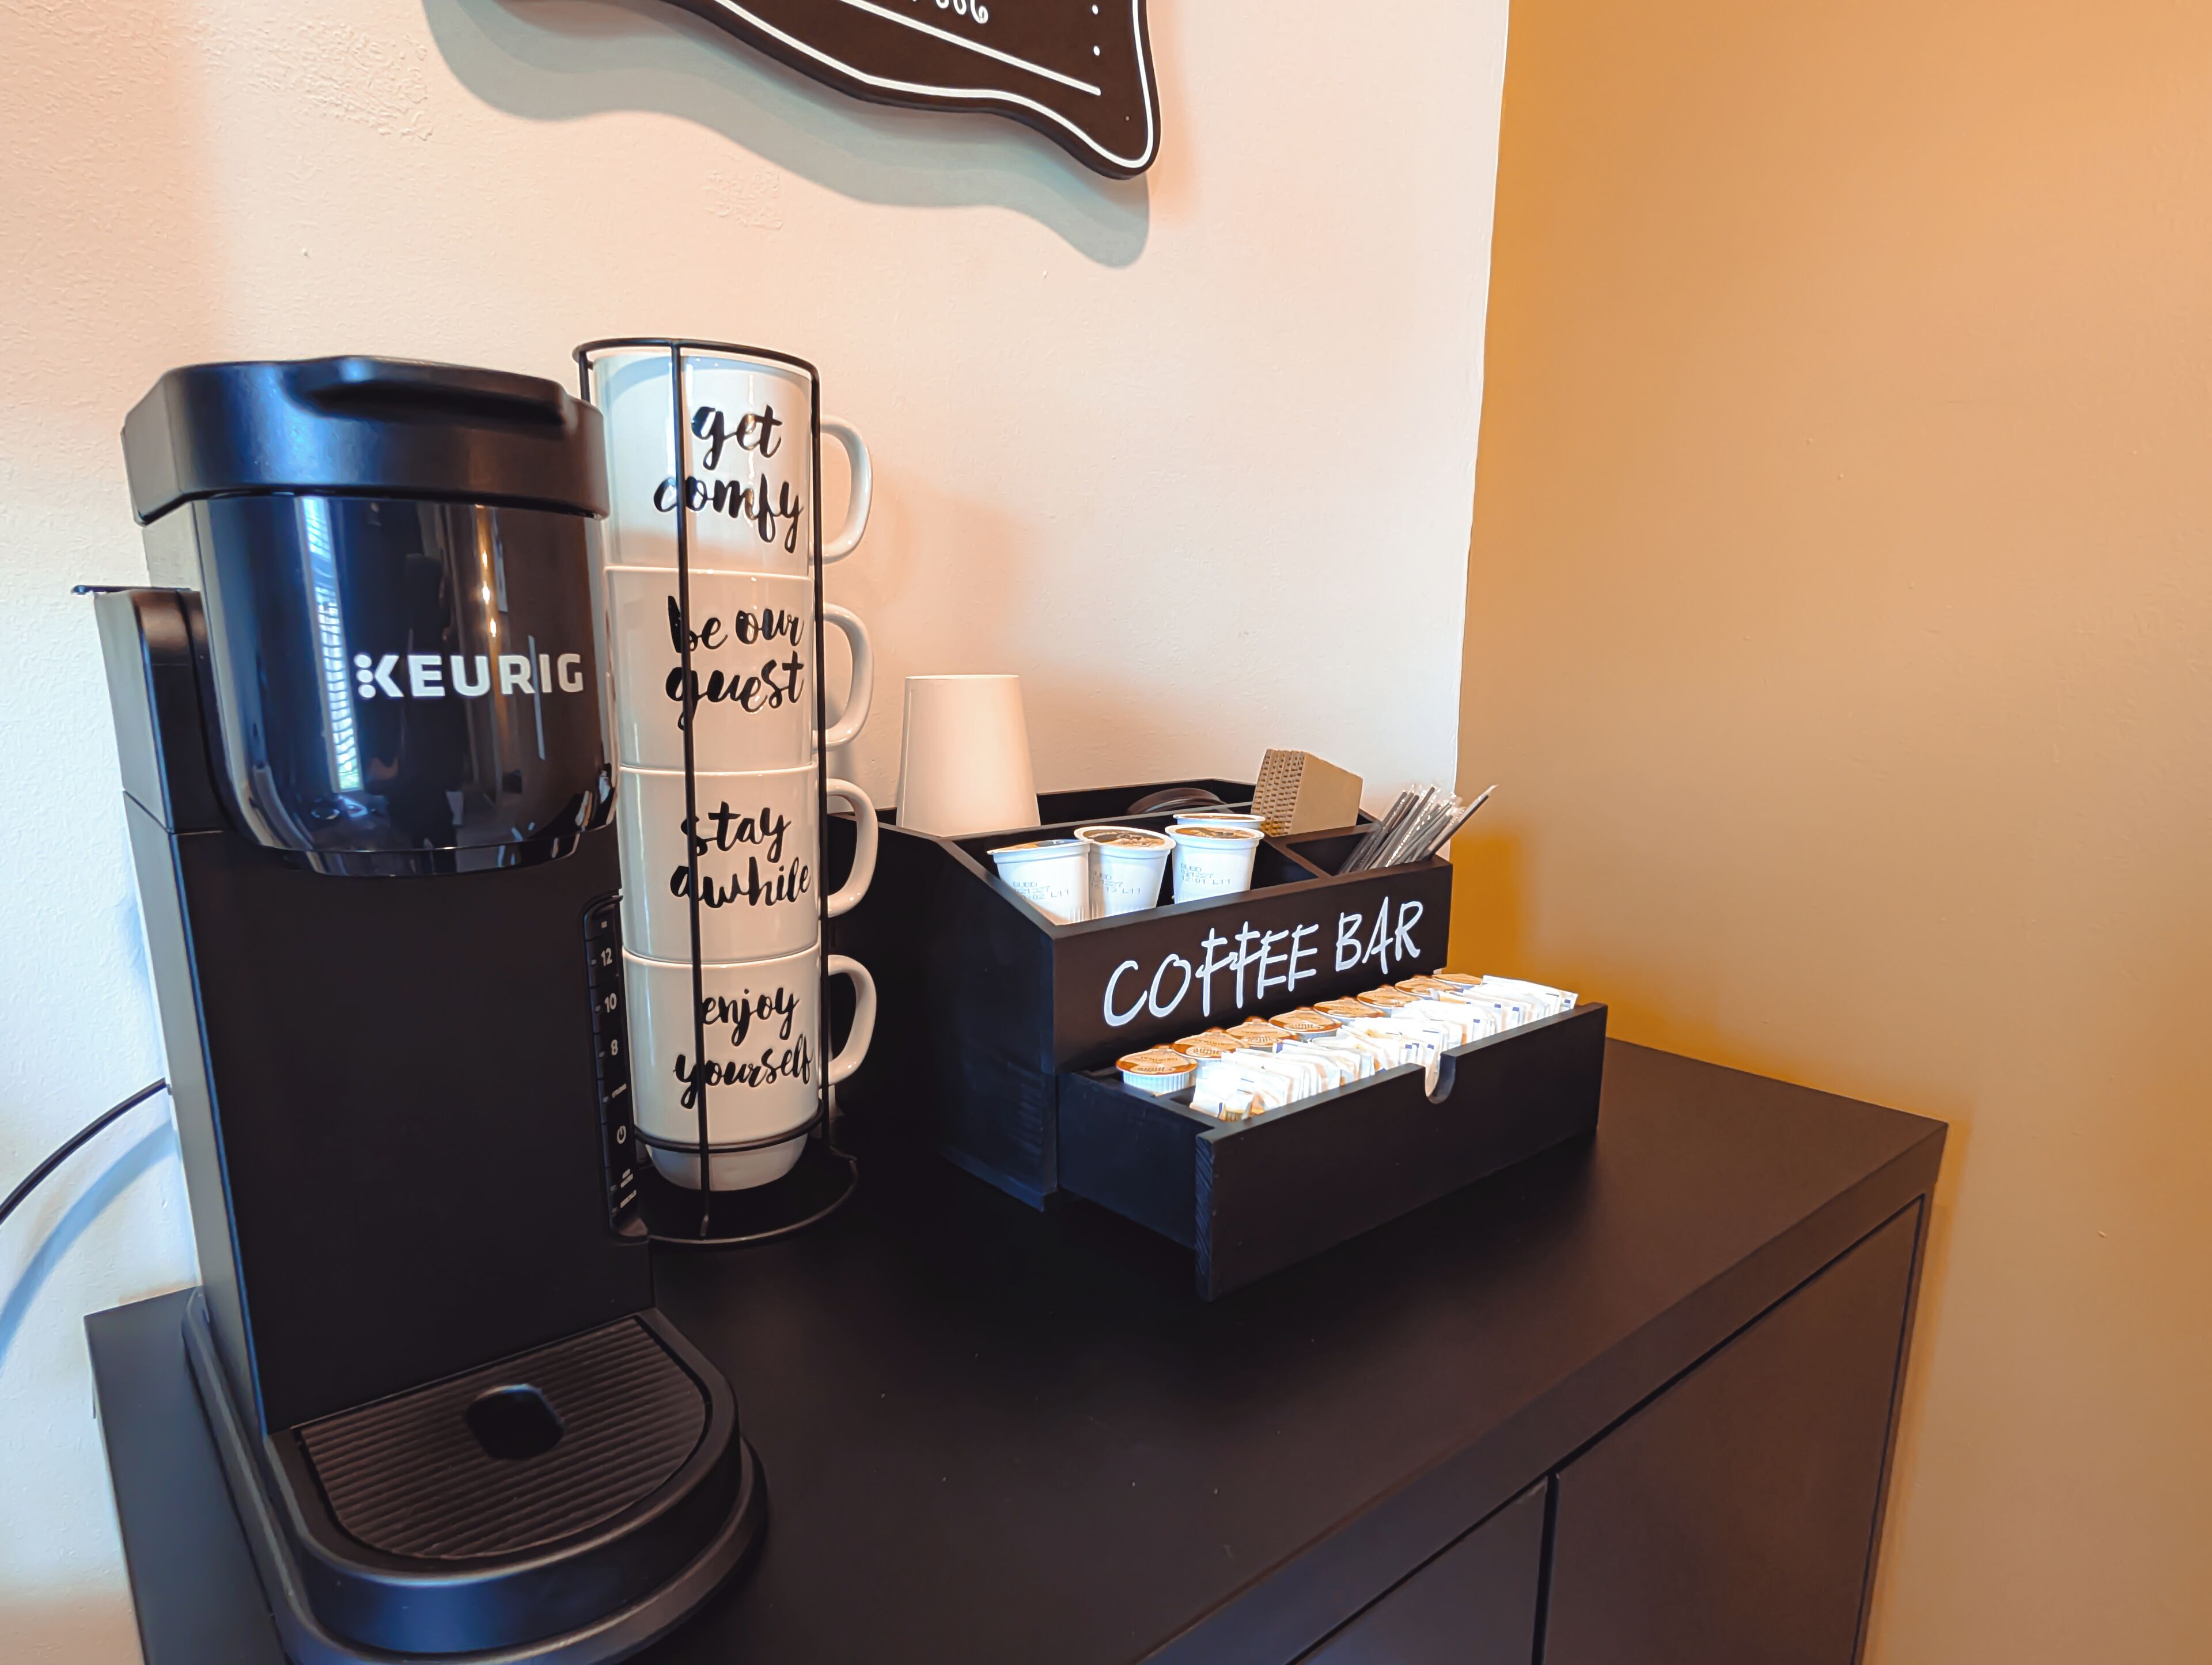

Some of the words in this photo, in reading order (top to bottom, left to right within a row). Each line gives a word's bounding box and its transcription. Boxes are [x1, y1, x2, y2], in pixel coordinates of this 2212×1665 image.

[691, 404, 783, 471] get
[653, 473, 804, 554] comfy
[668, 596, 728, 654] be
[735, 608, 805, 647] our
[354, 653, 584, 699] KEURIG
[665, 650, 805, 731] guest
[680, 801, 792, 863] stay
[670, 856, 812, 909] awhile
[601, 947, 613, 967] 12
[1103, 921, 1319, 1027] COFFEE
[1335, 896, 1423, 974] BAR
[604, 993, 617, 1013] 10
[700, 987, 800, 1047] enjoy
[611, 1039, 619, 1056] 8
[673, 1033, 815, 1109] yourself
